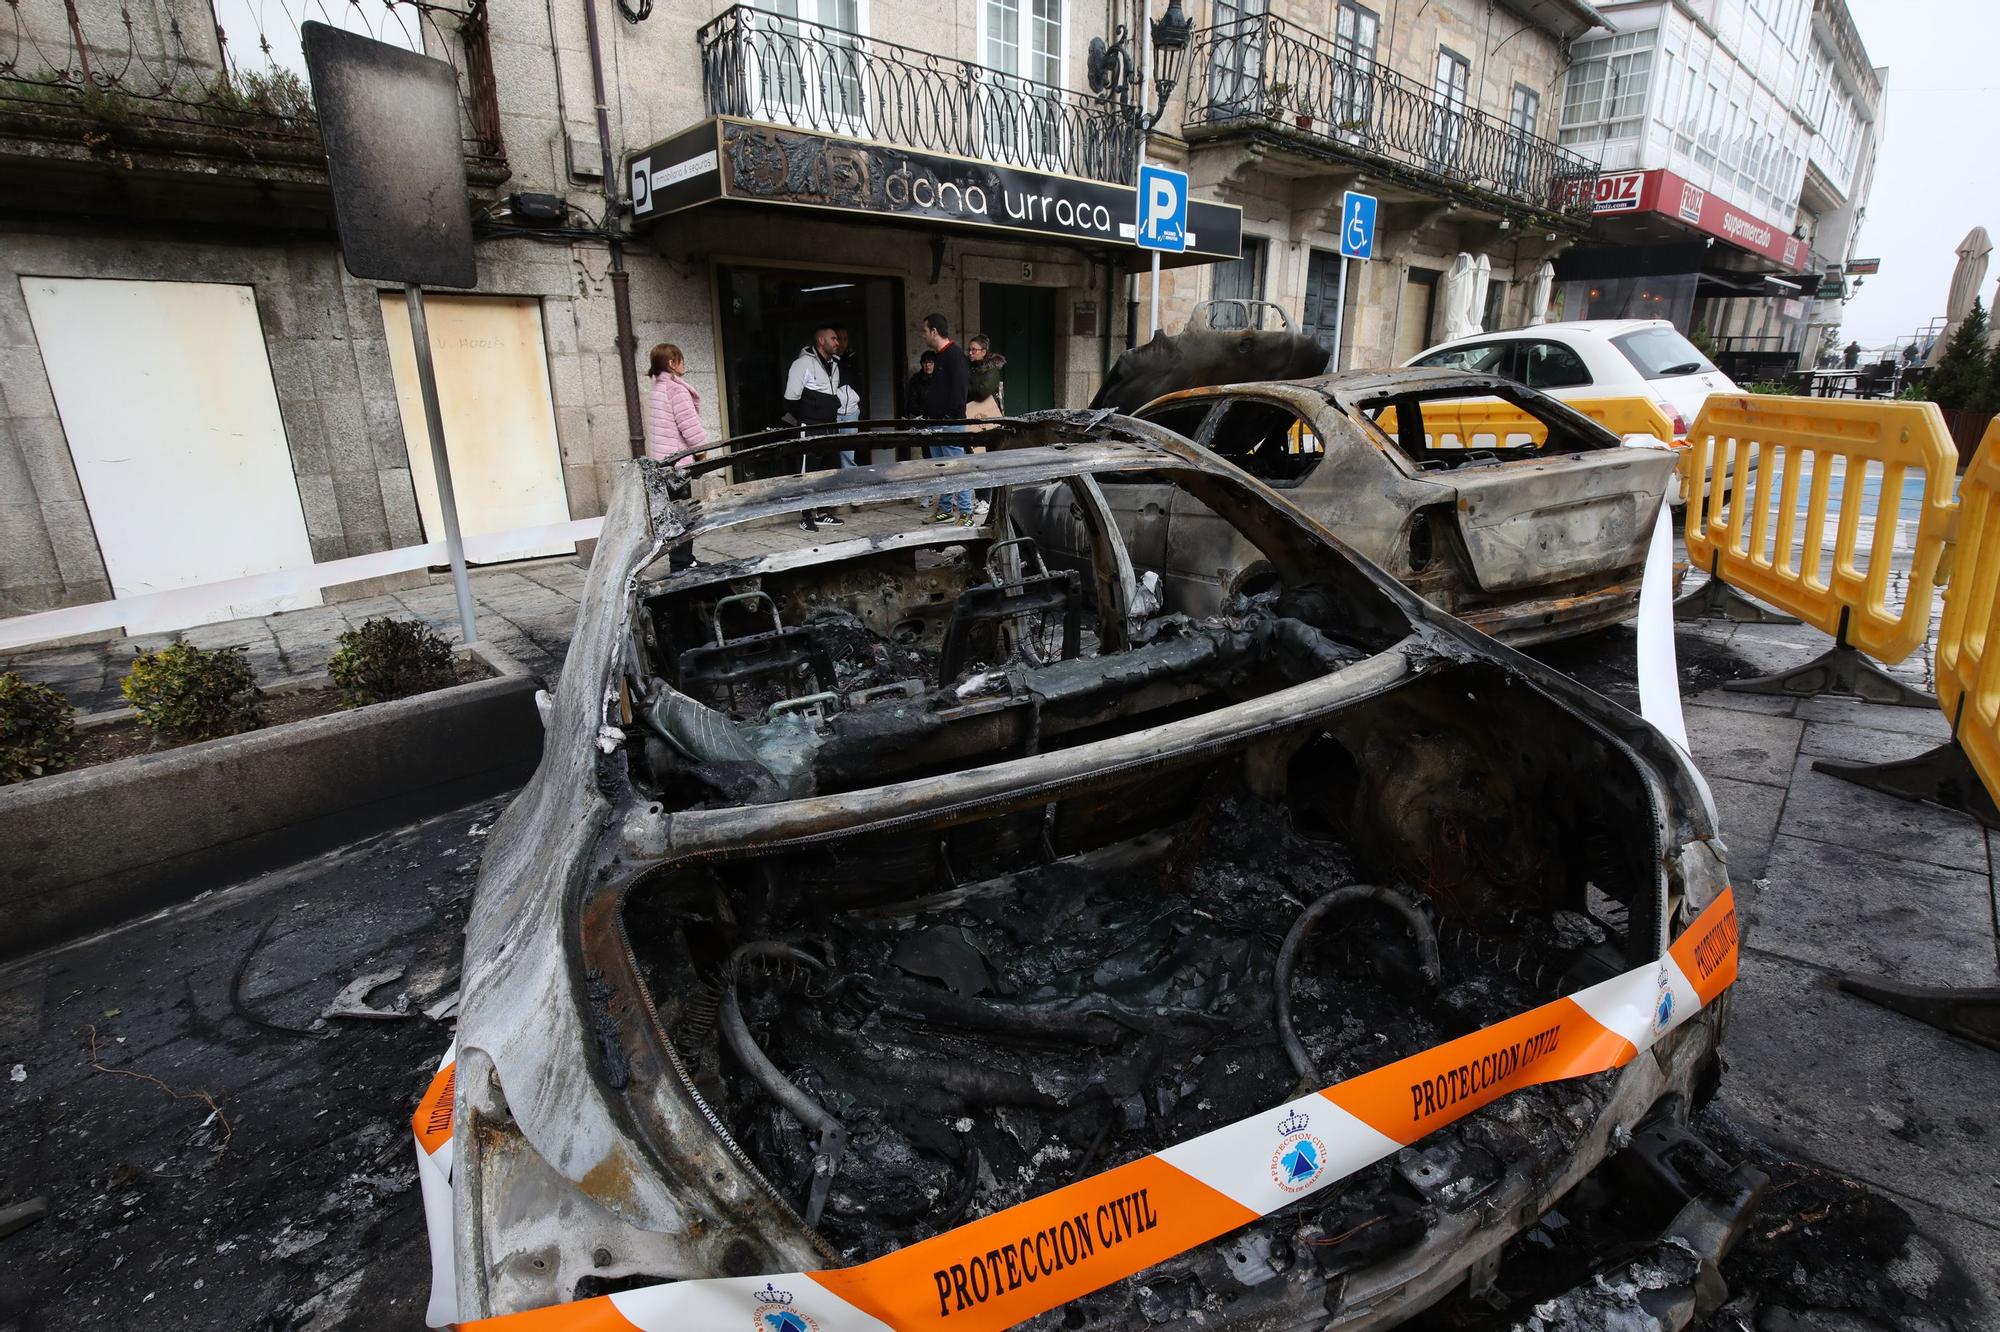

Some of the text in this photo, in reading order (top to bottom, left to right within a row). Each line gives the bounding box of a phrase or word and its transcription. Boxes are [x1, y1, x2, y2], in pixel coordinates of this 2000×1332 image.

[689, 158, 711, 175] seguros
[1003, 190, 1110, 231] urraca
[1147, 176, 1178, 239] P
[1722, 212, 1771, 248] supermercado
[1023, 263, 1031, 278] 5
[1411, 1025, 1560, 1121] PROTECCION CIVIL
[426, 1108, 453, 1134] CIVIL
[1271, 1132, 1327, 1176] PROTECCION CIVIL
[933, 1188, 1157, 1317] PROTECCION CIVIL
